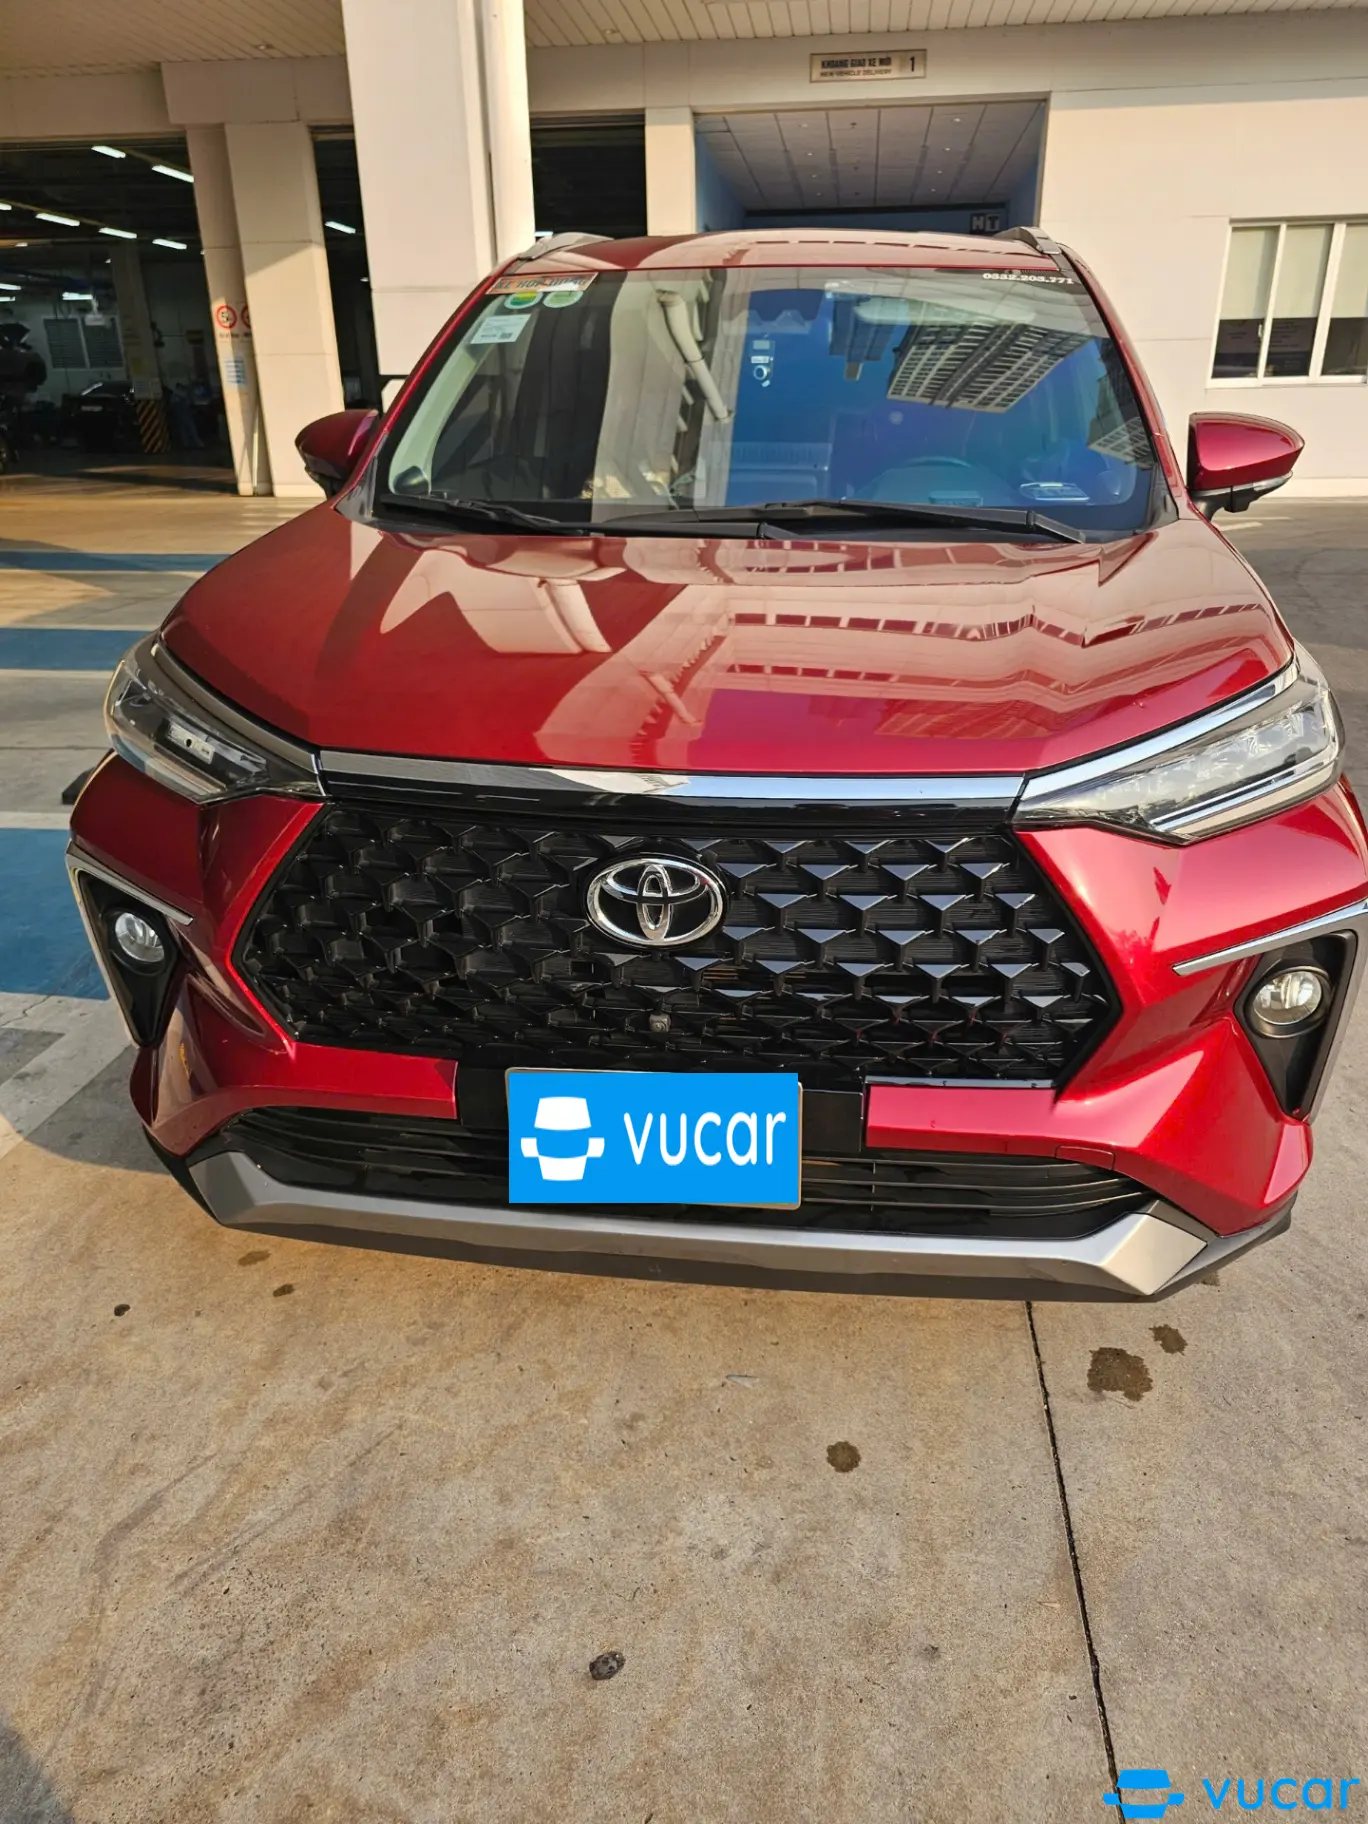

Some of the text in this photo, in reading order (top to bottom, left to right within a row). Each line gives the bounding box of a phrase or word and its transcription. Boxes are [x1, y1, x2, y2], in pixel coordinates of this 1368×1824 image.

[868, 58, 877, 67] XE
[909, 56, 916, 72] 1
[836, 69, 861, 77] VEHICLE
